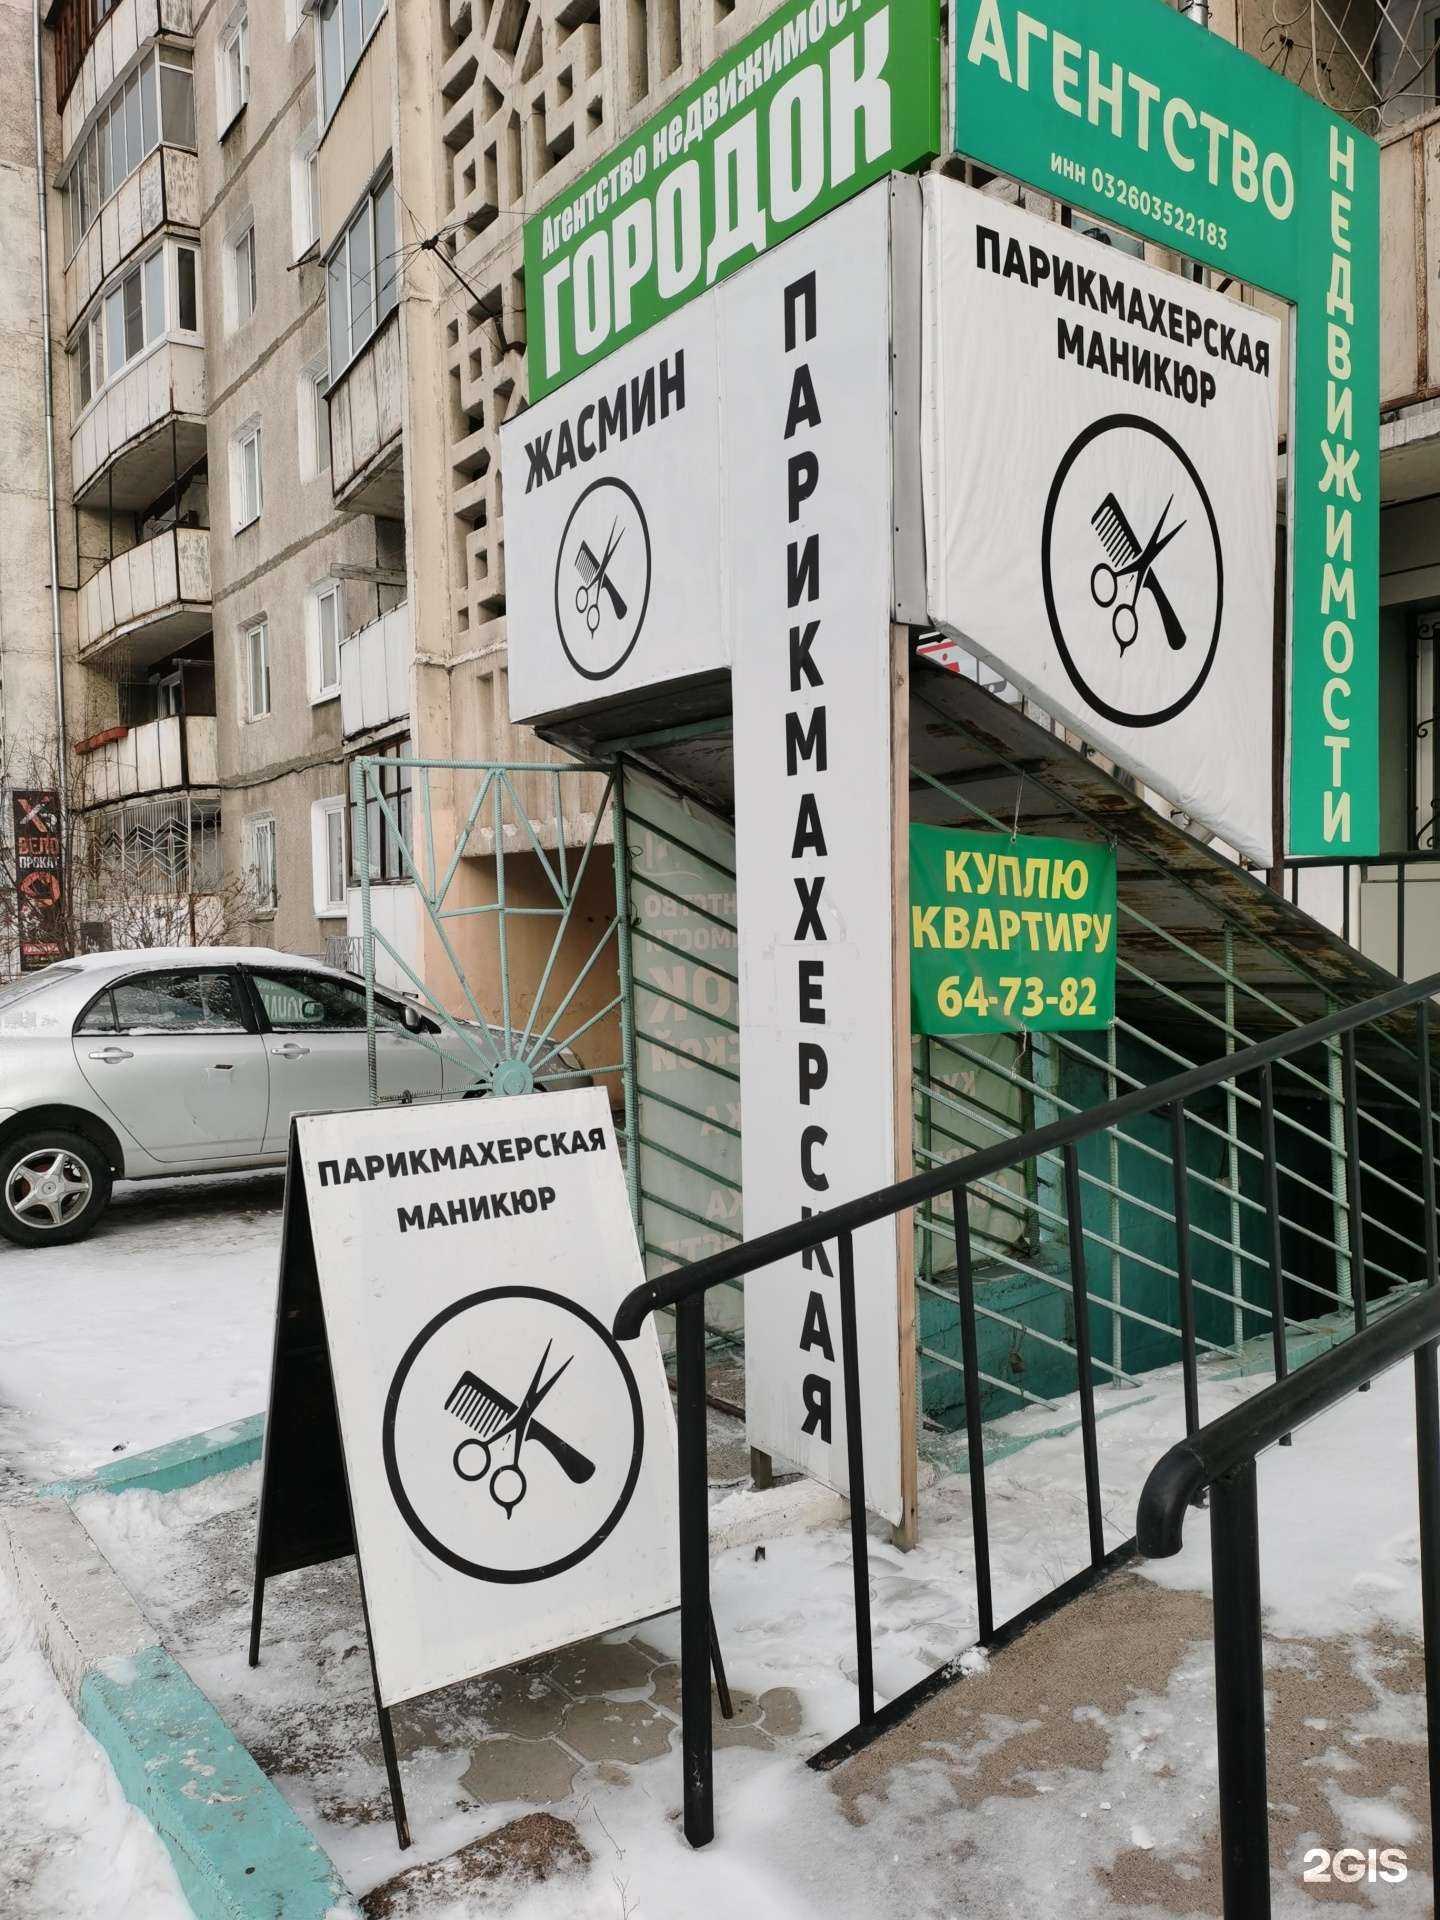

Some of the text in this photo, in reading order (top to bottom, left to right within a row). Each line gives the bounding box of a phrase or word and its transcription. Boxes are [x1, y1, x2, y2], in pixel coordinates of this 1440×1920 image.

[653, 0, 861, 170] недвижимос
[967, 0, 1294, 220] АГЕНТСТВО
[543, 5, 892, 380] ГОРОДОК
[1092, 167, 1228, 251] 032603522183
[976, 224, 1269, 377] ПАРИКМАХЕРСКАЯ
[1057, 317, 1217, 408] МАНИКЮР
[523, 348, 686, 495] ЖАСМИН
[1318, 125, 1362, 844] НЕДВИЖИМОСТИ
[945, 850, 1089, 900] КУПЛЮ
[911, 905, 1112, 953] КВАРТИРУ
[937, 975, 1097, 1018] 64-73-82
[318, 1128, 606, 1187] ПАРИКМАХЕРСКАЯ
[397, 1187, 556, 1233] МАНИКЮР
